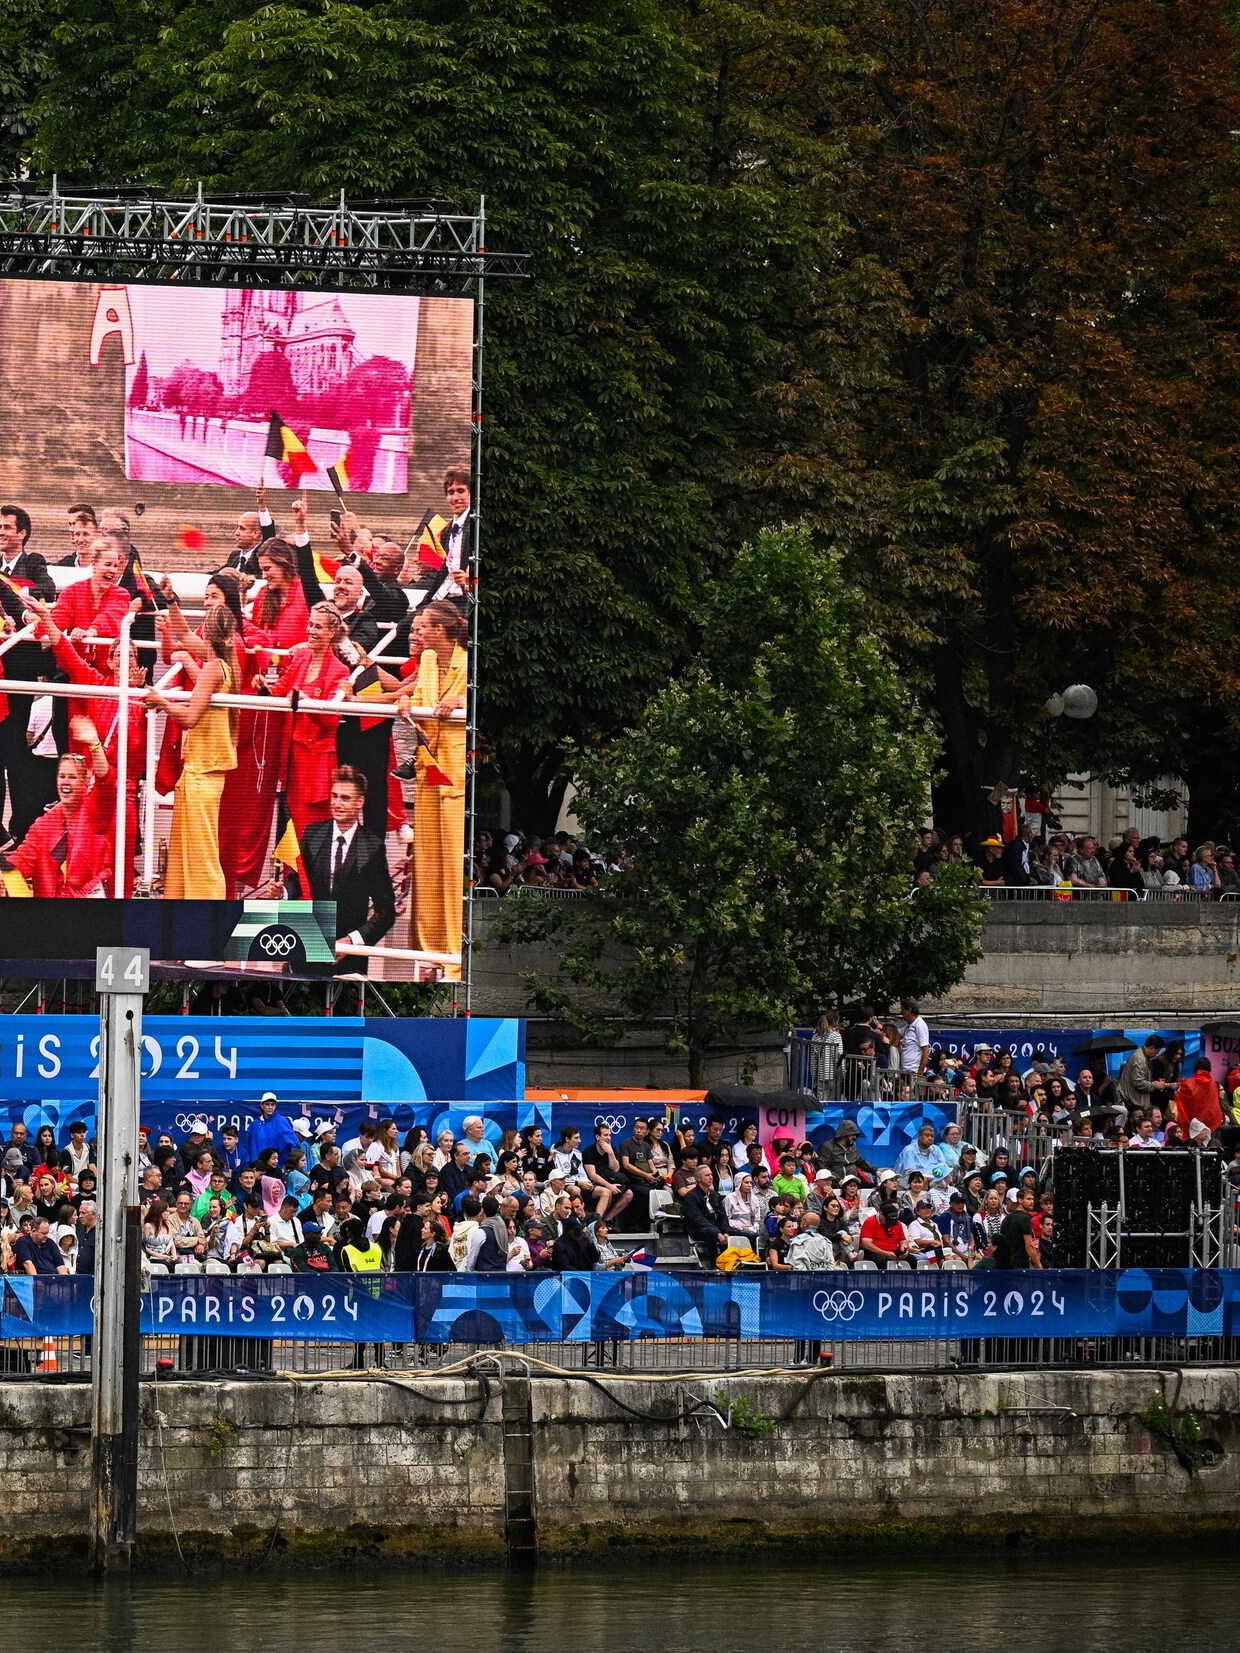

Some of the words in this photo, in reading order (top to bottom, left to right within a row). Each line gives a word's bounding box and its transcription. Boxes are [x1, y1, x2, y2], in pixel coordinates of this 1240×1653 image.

[88, 287, 135, 366] A
[765, 1107, 798, 1127] C01
[271, 1293, 359, 1322] 2024
[982, 1290, 1066, 1317] 2024
